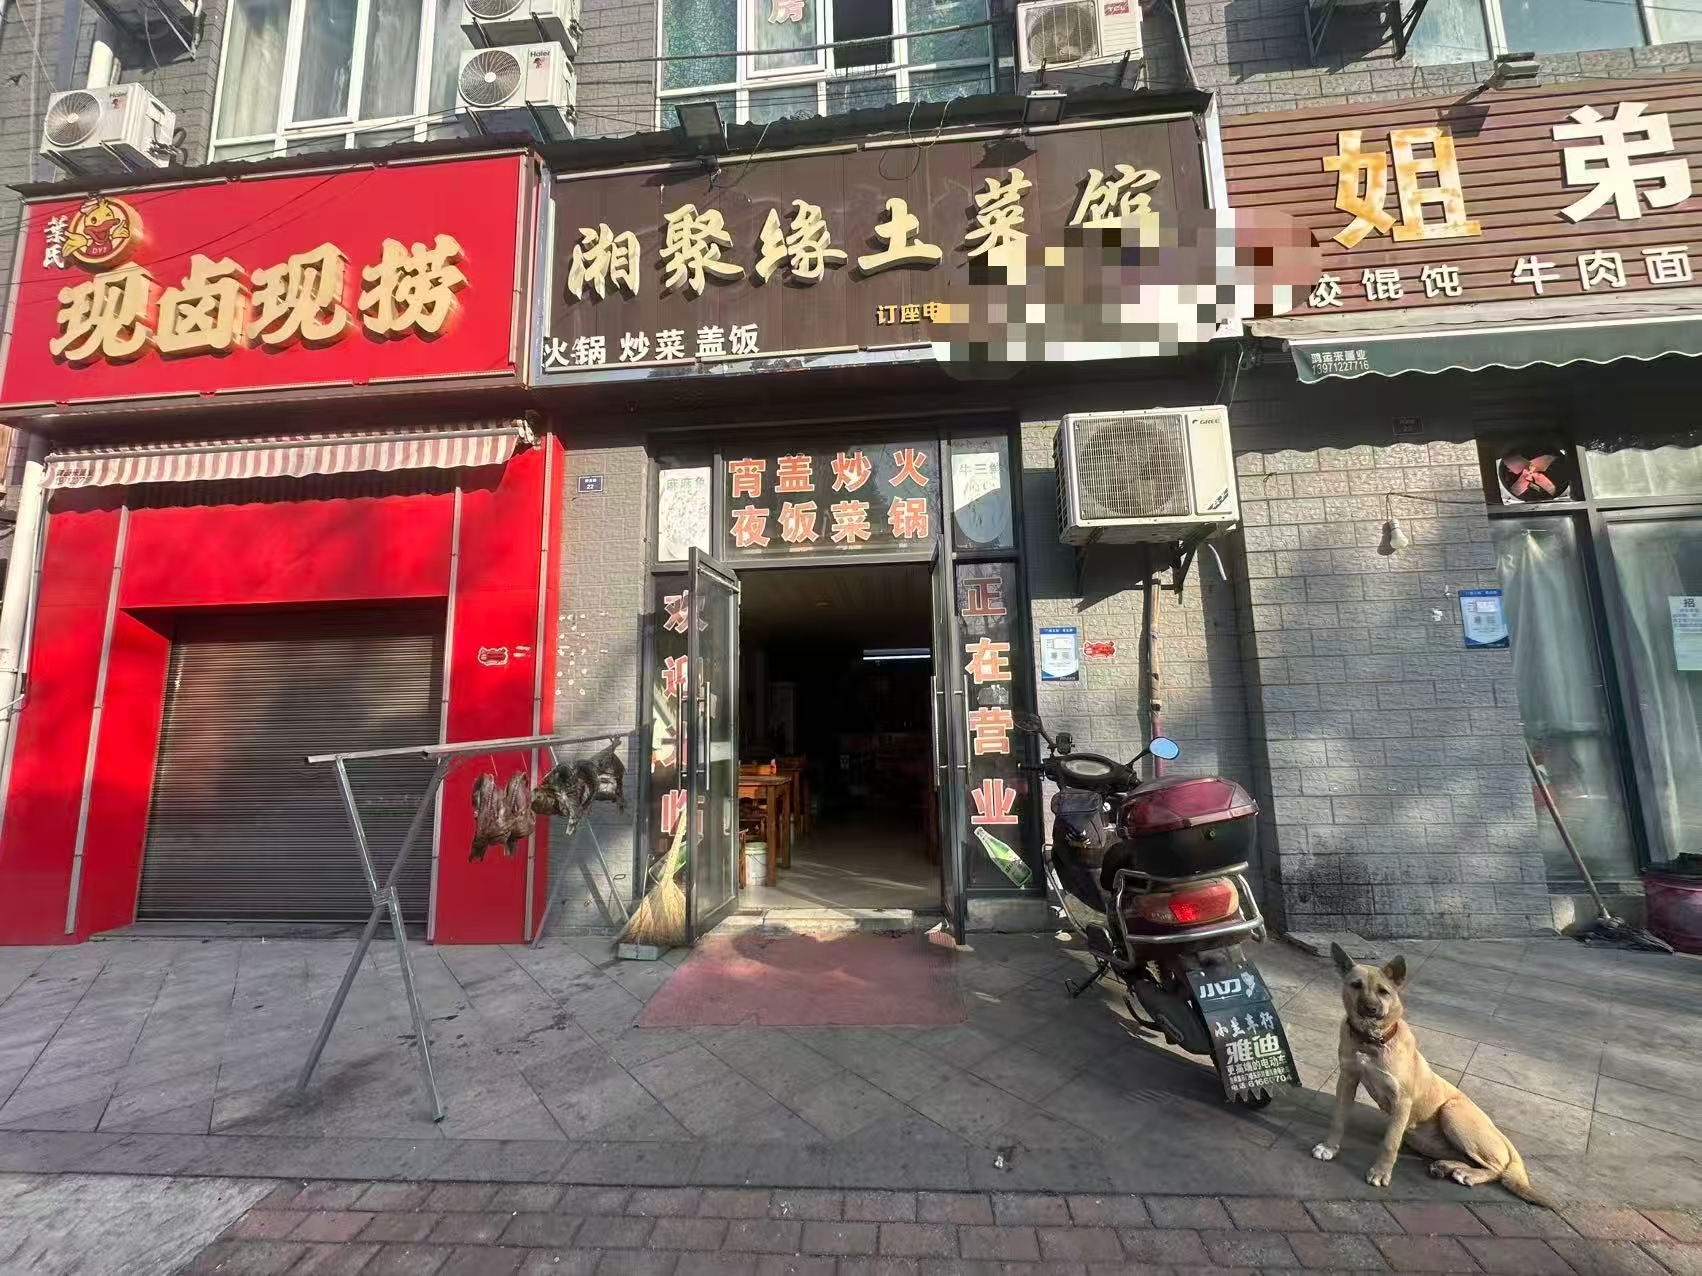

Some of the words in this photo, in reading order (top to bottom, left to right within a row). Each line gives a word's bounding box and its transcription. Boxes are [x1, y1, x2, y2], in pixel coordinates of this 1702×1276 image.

[1322, 102, 1693, 249] 姐弟
[567, 163, 1162, 300] 湘聚缘土菜馆
[1513, 246, 1692, 296] 牛肉面
[48, 234, 469, 362] 现卤现捞
[544, 335, 606, 367] 火锅
[619, 329, 686, 362] 炒菜
[695, 323, 760, 358] 盖饭
[1312, 360, 1369, 375] 13971227716
[962, 577, 1019, 824] 正在营业
[1225, 1032, 1282, 1065] 雅迪
